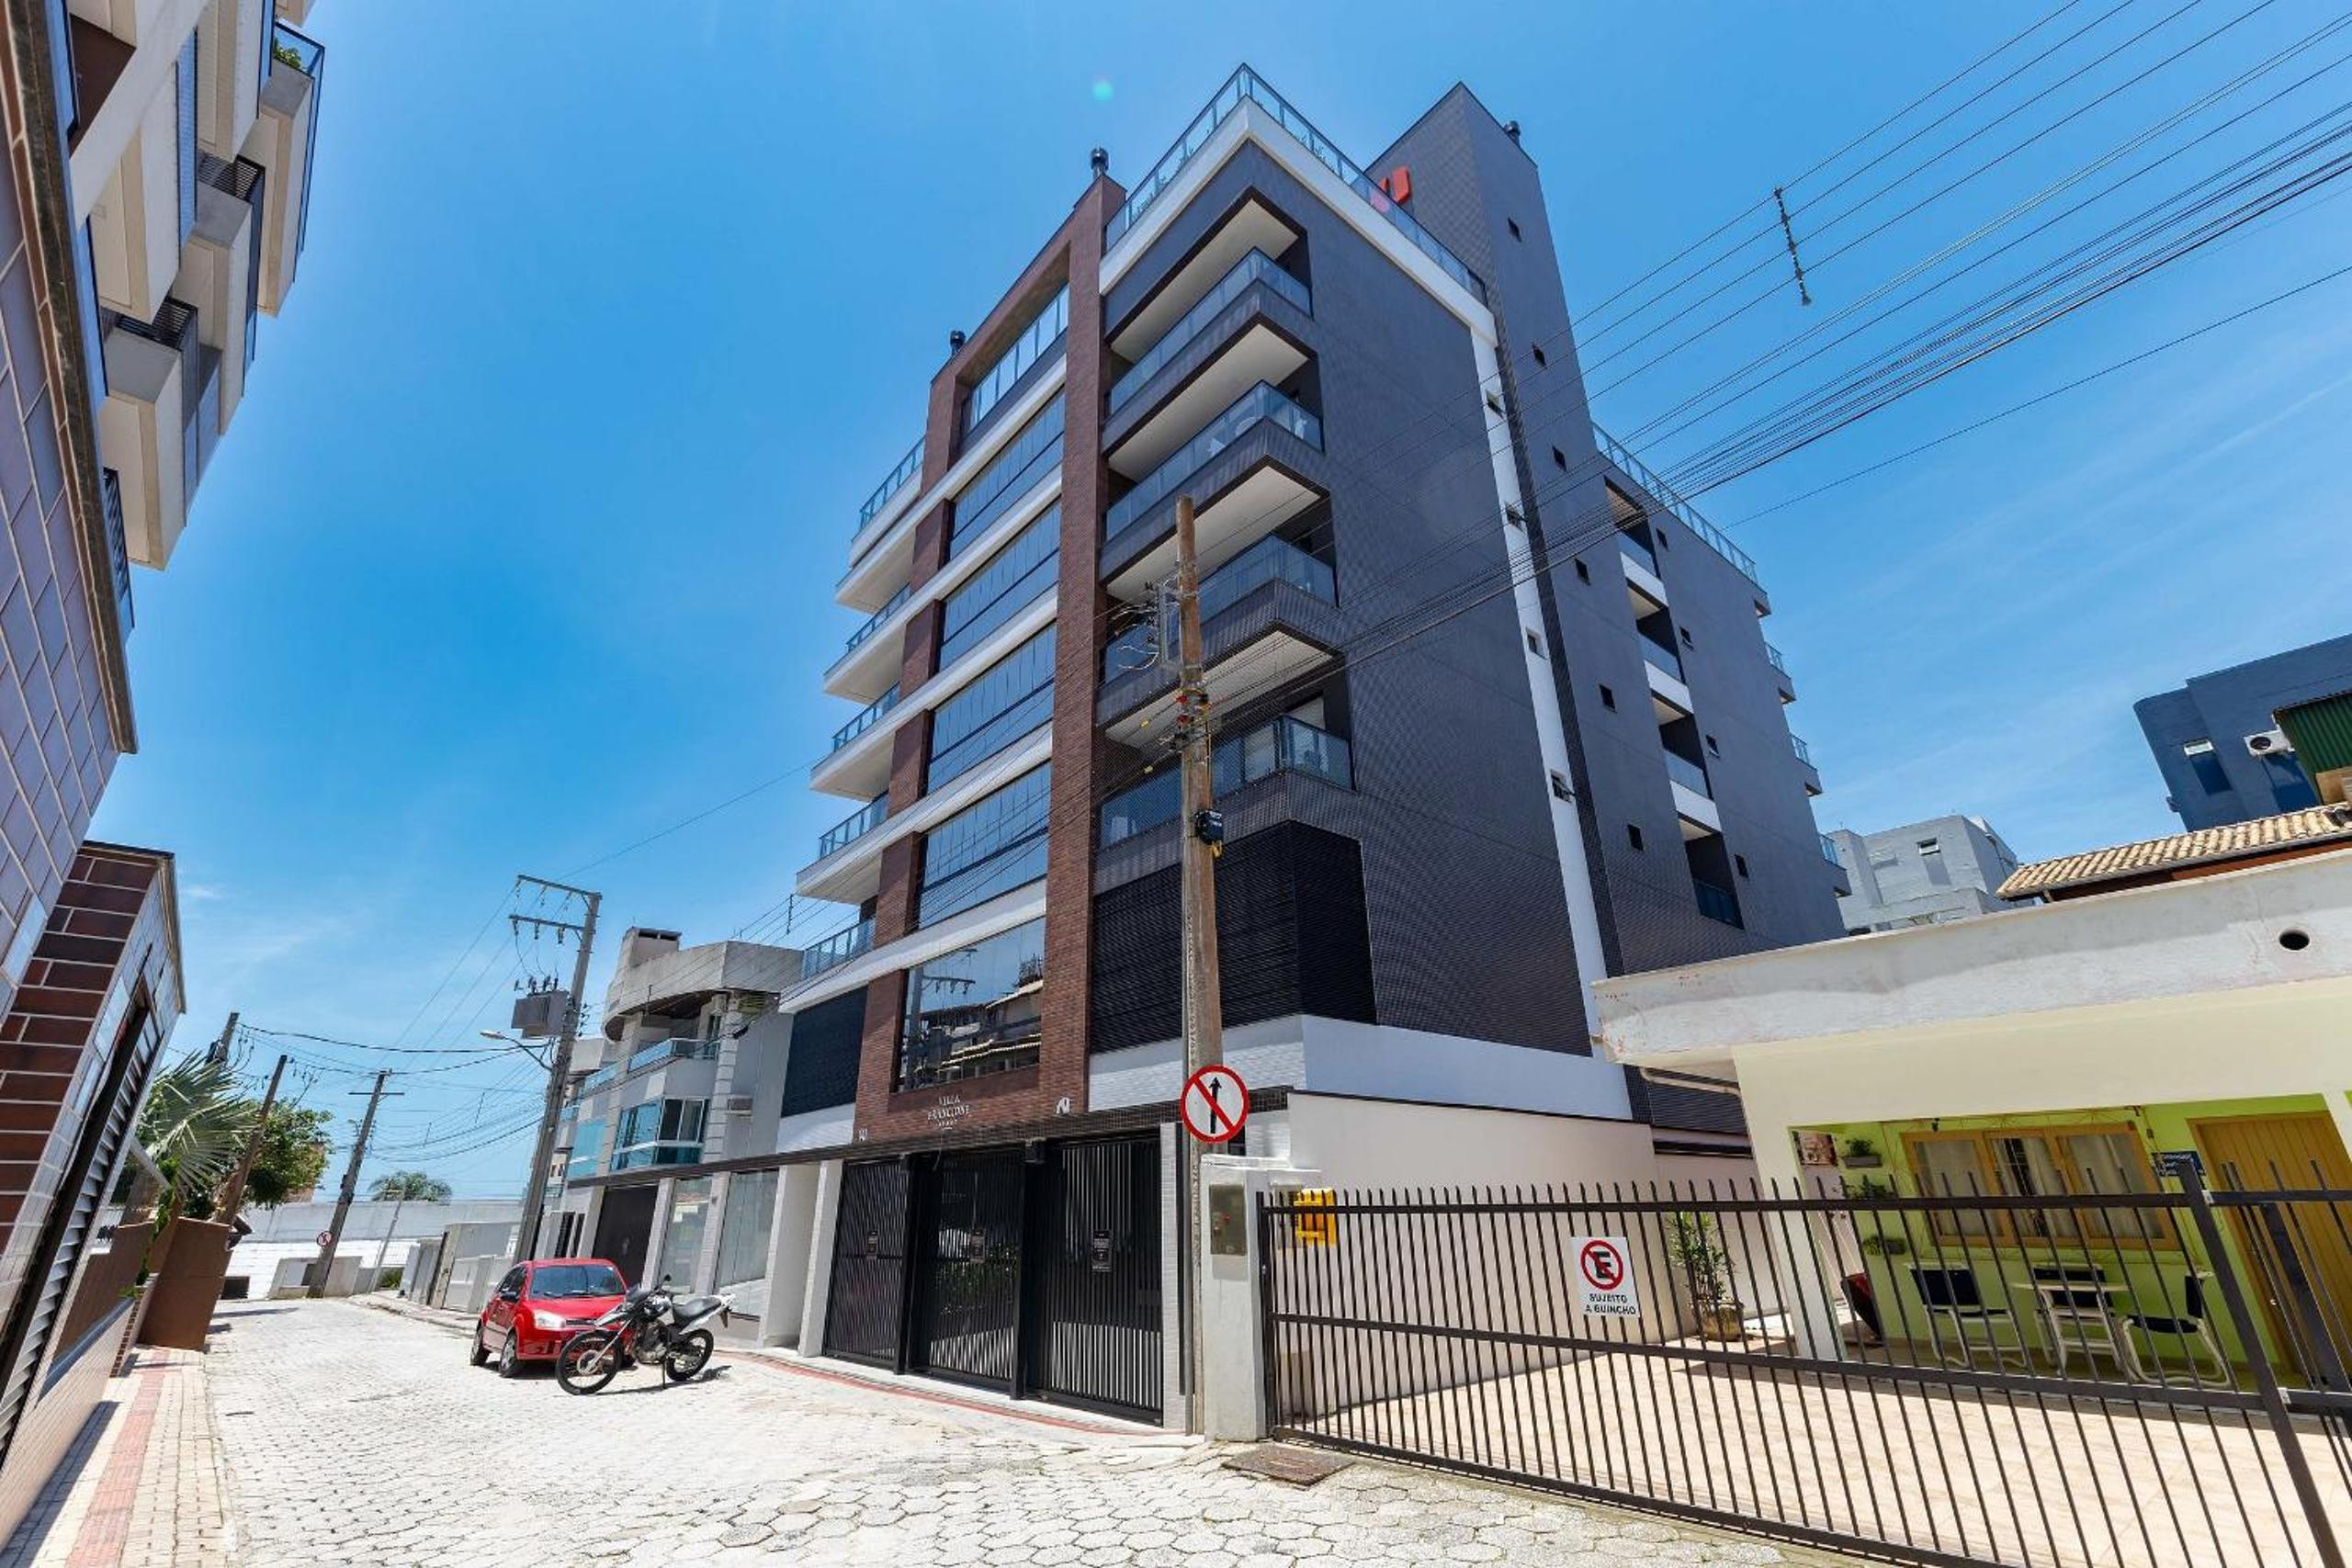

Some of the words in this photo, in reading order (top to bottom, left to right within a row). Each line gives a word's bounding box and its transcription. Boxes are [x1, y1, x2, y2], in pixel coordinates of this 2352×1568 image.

[1593, 1250, 1614, 1279] E
[1589, 1292, 1628, 1303] SUJEITO
[1585, 1304, 1593, 1314] A
[1594, 1304, 1636, 1314] GUINCHO
